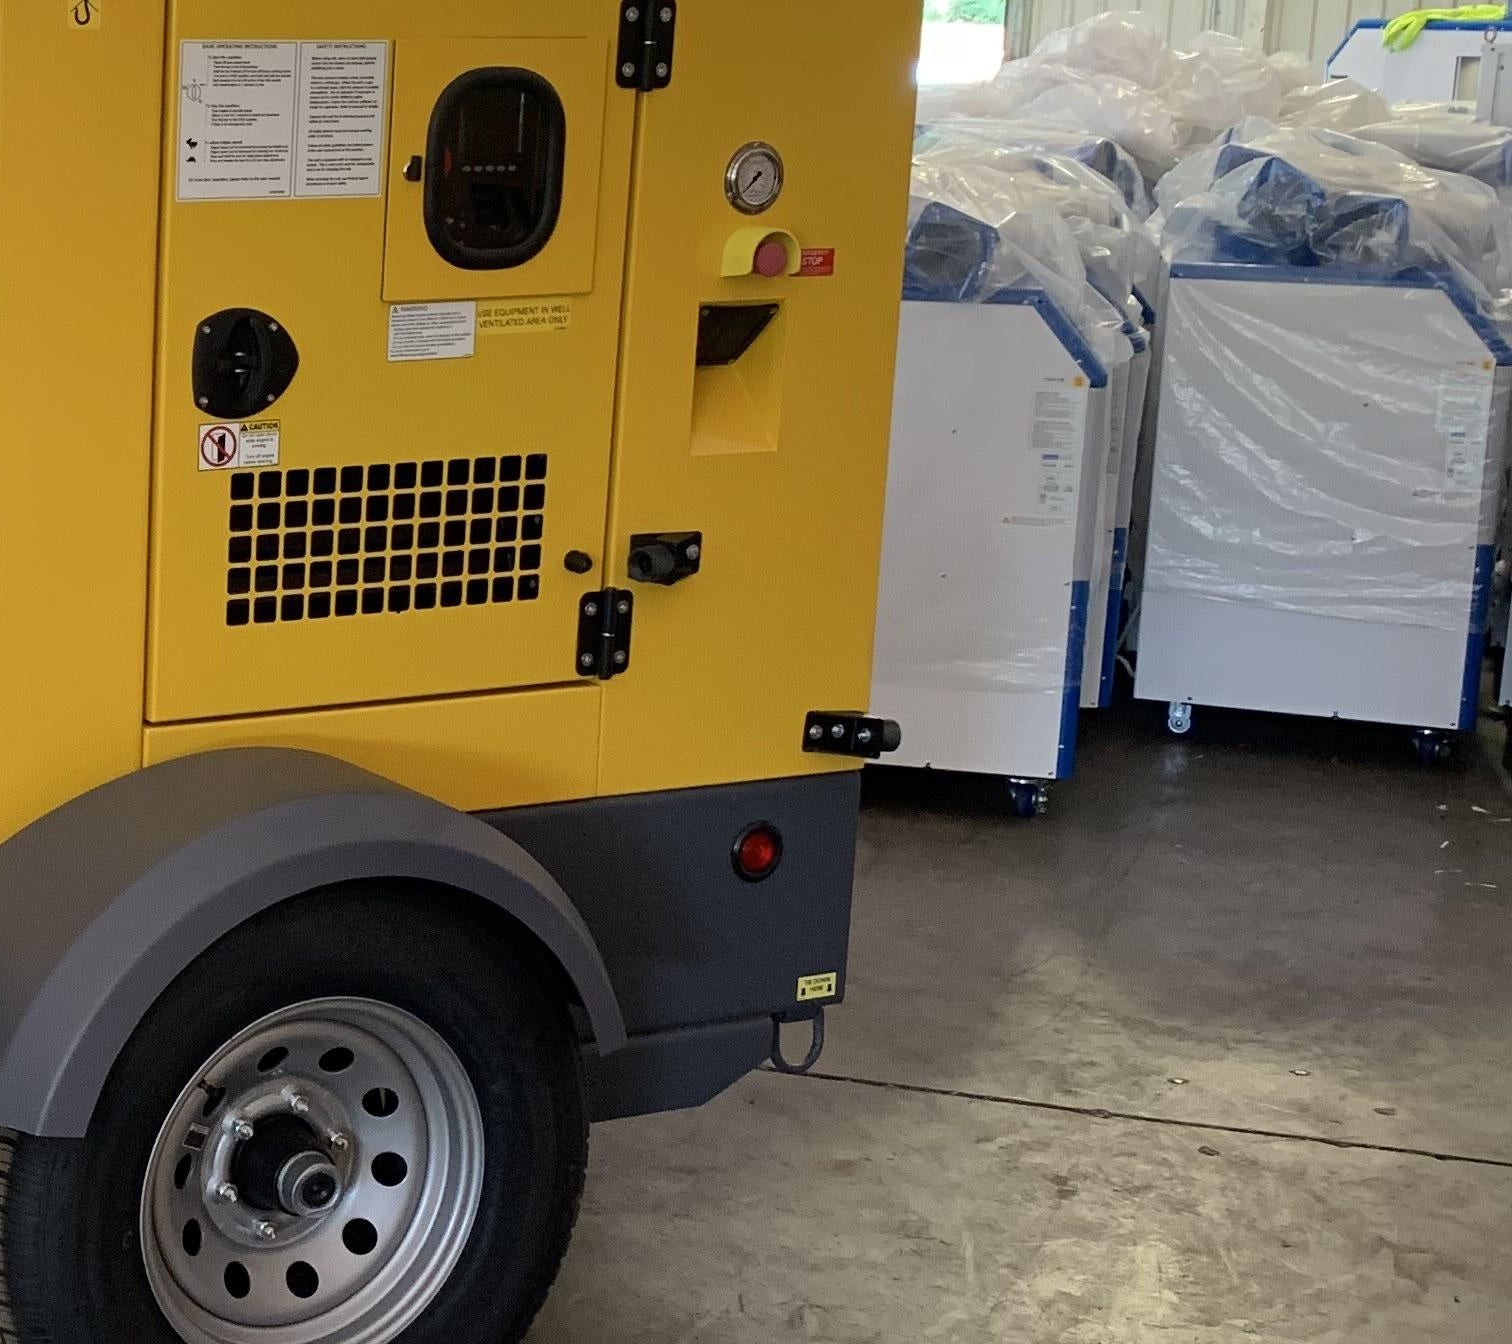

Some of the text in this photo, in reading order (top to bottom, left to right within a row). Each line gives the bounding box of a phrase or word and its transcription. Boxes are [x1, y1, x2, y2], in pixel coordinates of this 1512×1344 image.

[802, 256, 824, 266] STOP
[494, 306, 538, 316] EQUIPMENT
[551, 305, 570, 313] WELL
[479, 316, 568, 328] VENTILATED AREA ONLY
[248, 422, 278, 430] CAUTION
